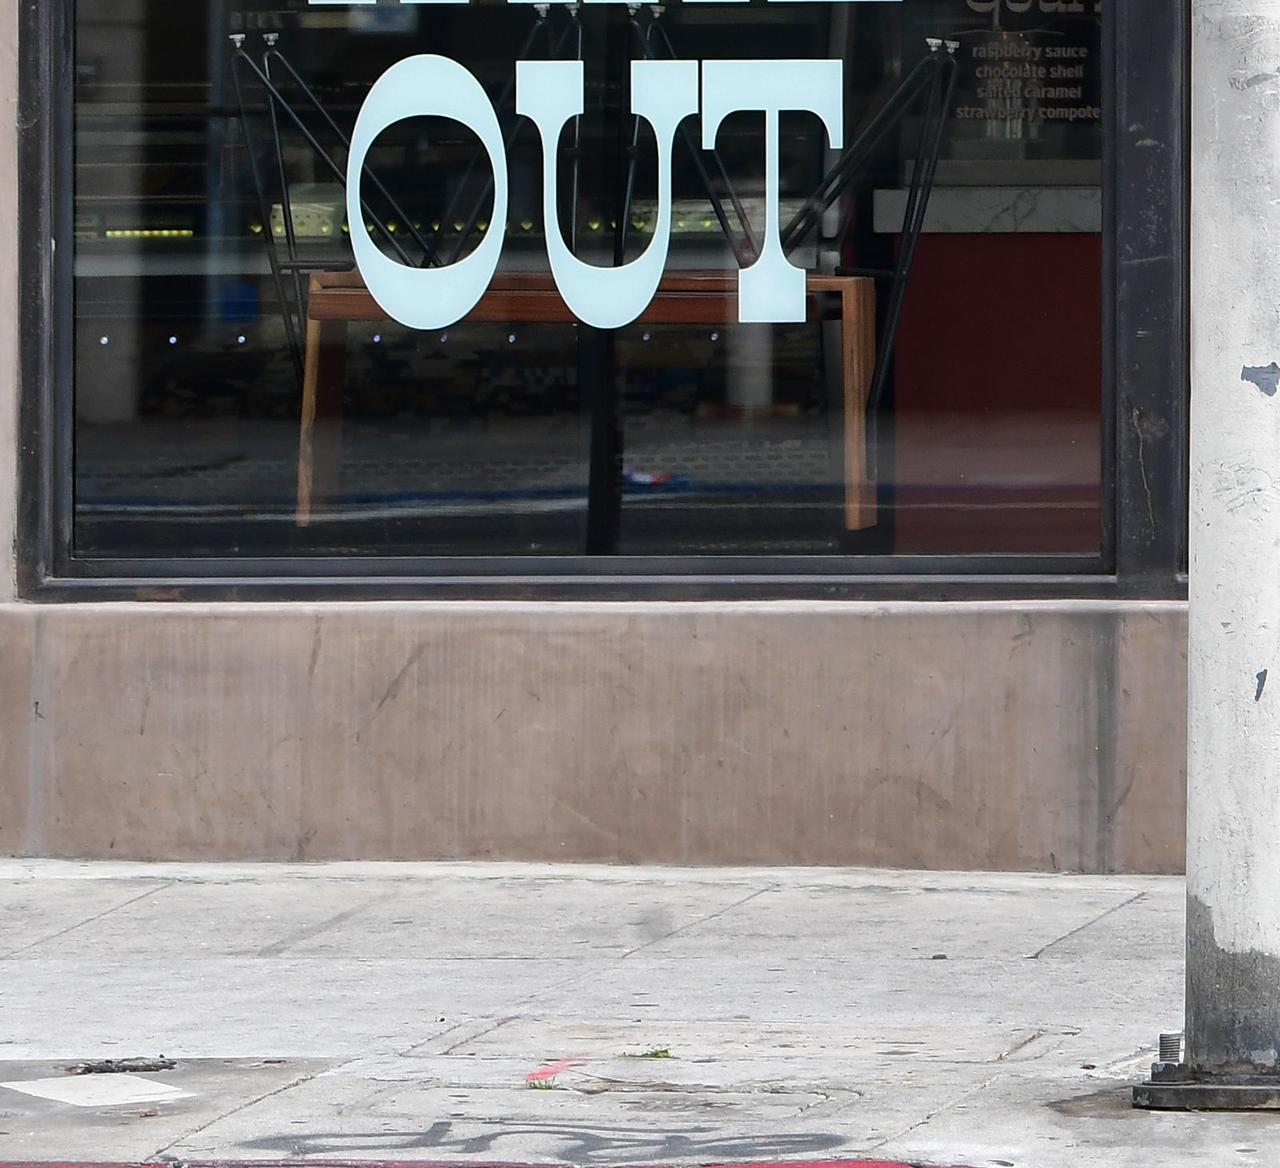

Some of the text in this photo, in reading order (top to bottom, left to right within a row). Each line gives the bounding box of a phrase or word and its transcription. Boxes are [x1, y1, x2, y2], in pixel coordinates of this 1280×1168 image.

[1045, 46, 1089, 58] sauce
[975, 63, 1084, 78] chocolate shell
[1023, 85, 1082, 99] caramel
[345, 52, 845, 330] OUT
